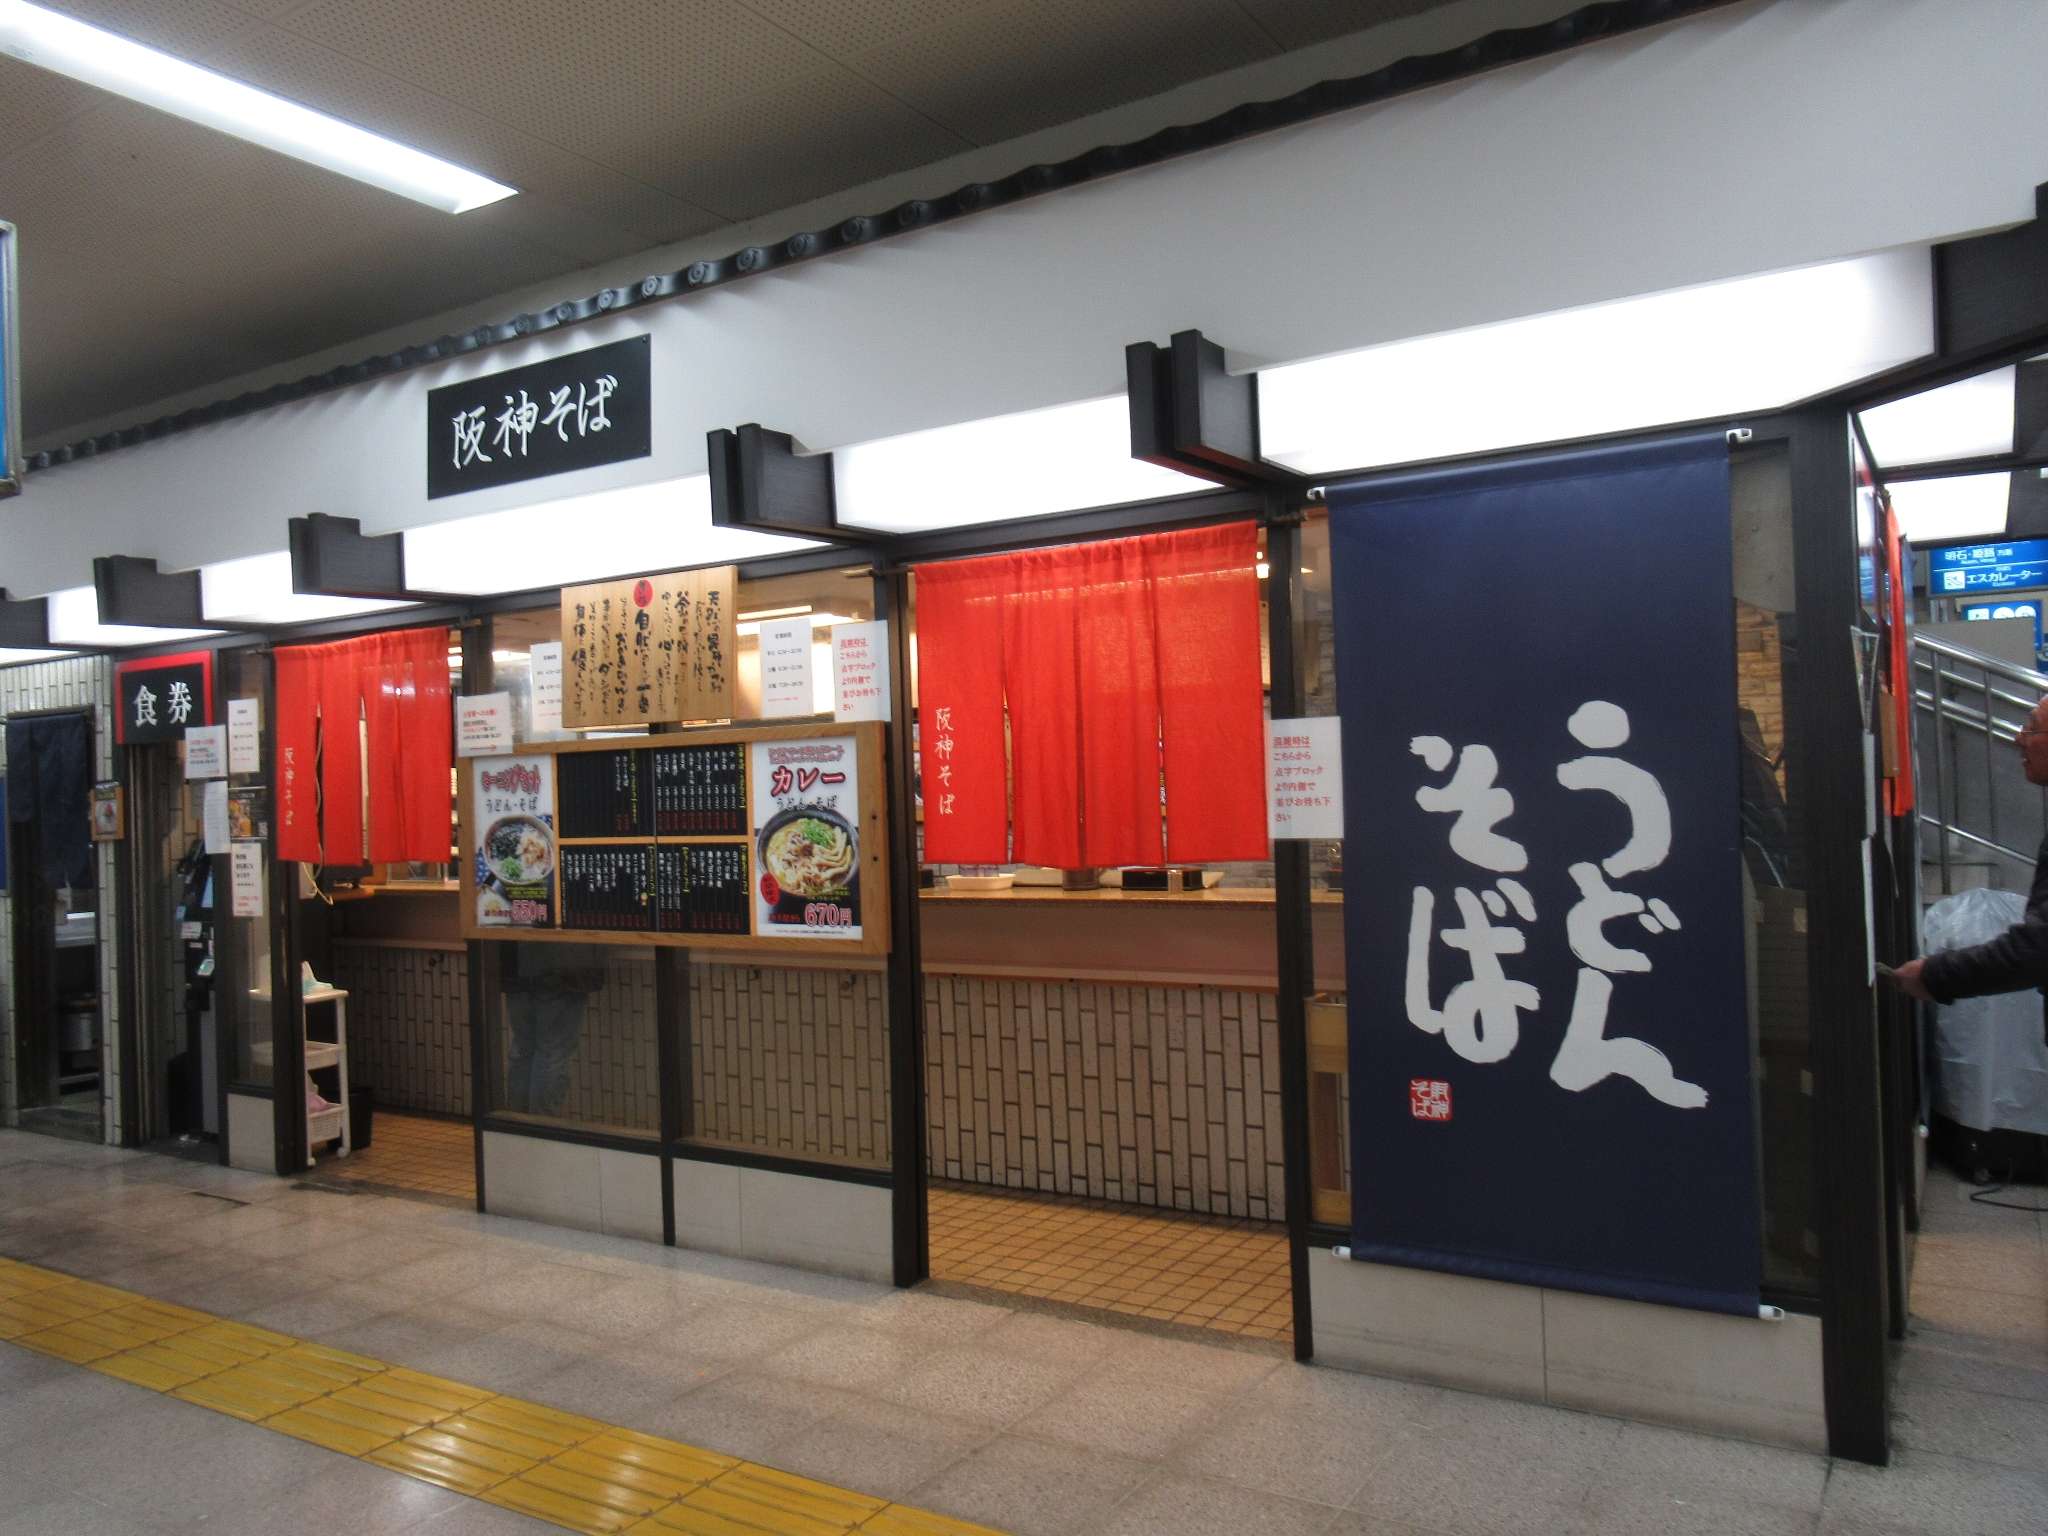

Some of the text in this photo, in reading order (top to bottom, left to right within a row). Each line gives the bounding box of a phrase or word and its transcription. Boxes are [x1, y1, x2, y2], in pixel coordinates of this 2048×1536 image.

[451, 374, 618, 470] 阪神そば
[1967, 570, 2042, 584] エスカレーター
[134, 681, 193, 728] 食券
[934, 706, 955, 815] 阪神そば
[1273, 751, 1311, 760] こちらから
[1274, 765, 1324, 776] 点字ブロック
[770, 765, 846, 797] カレー
[1275, 782, 1316, 791] より内側で
[804, 902, 853, 928] 670円
[1404, 734, 1541, 1064] そば
[1549, 700, 1710, 1109] うどん
